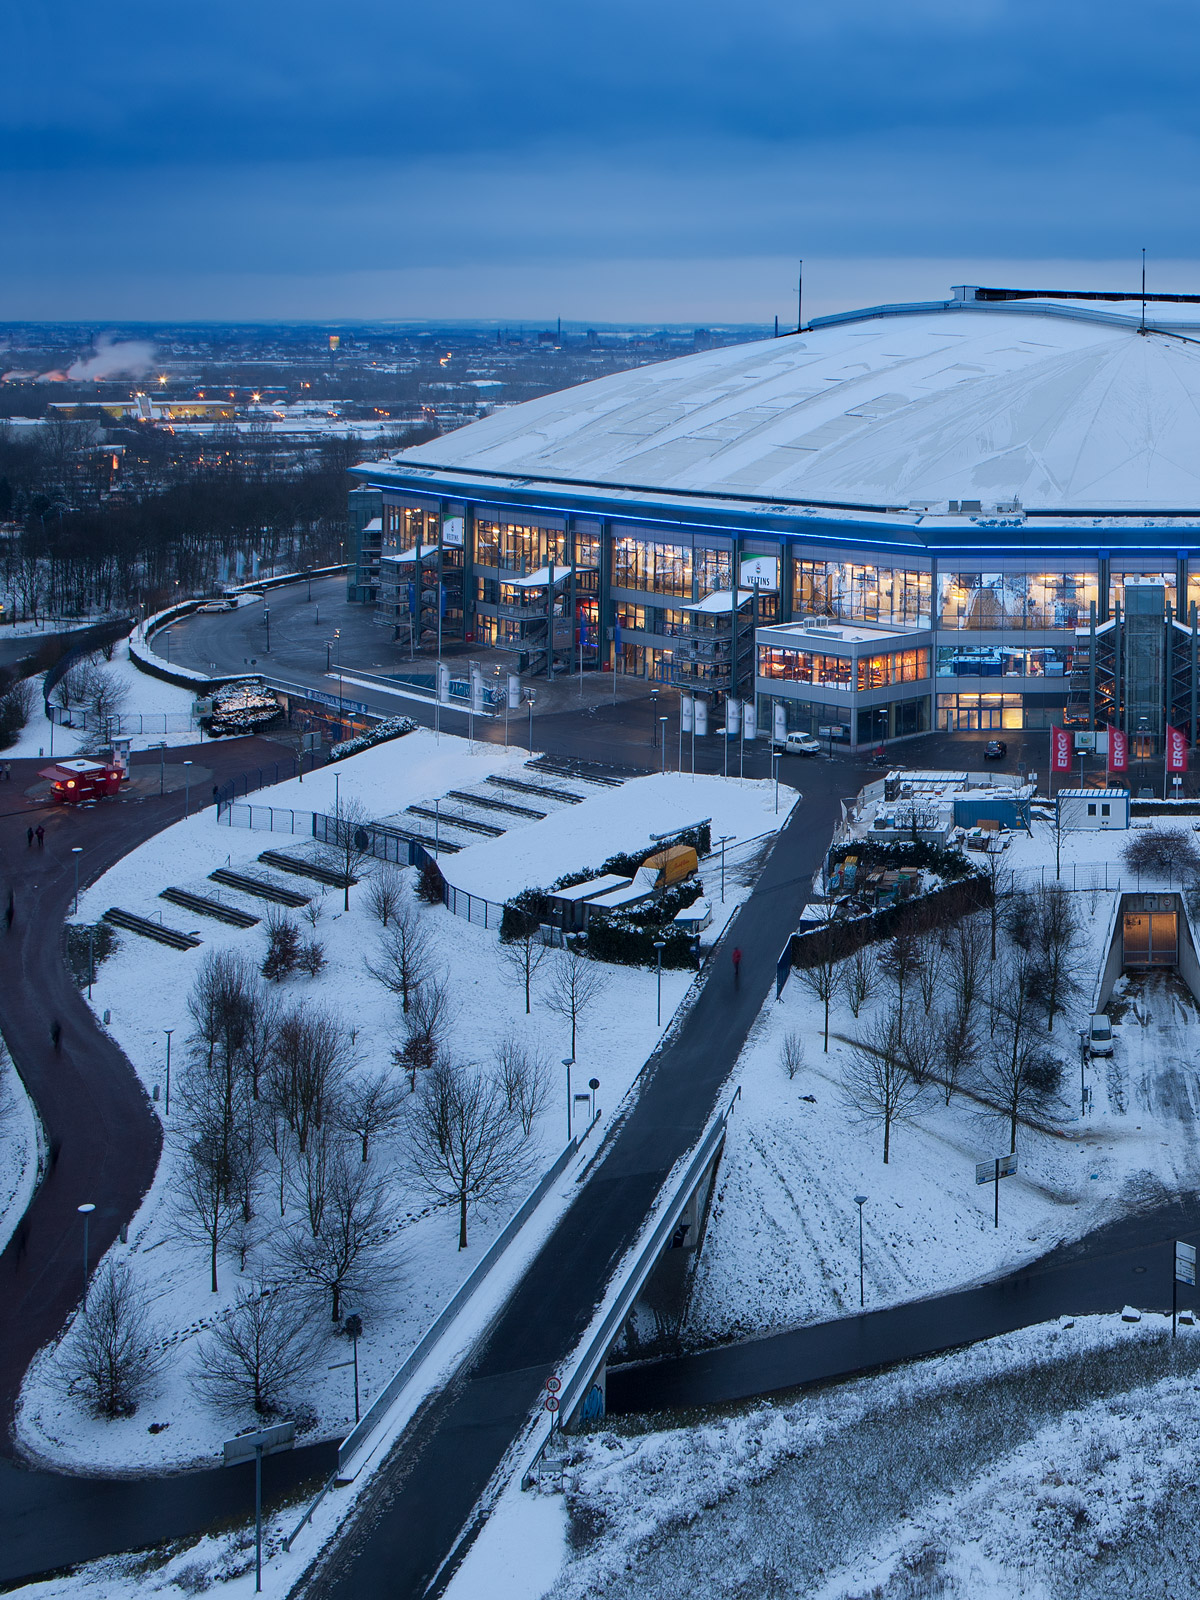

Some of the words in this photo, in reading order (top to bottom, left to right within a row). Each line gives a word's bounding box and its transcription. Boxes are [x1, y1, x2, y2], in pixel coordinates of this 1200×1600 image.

[747, 576, 770, 586] VELTINS
[1057, 733, 1068, 767] ERGO
[1113, 732, 1124, 767] ERGO
[1172, 732, 1184, 767] ERGO
